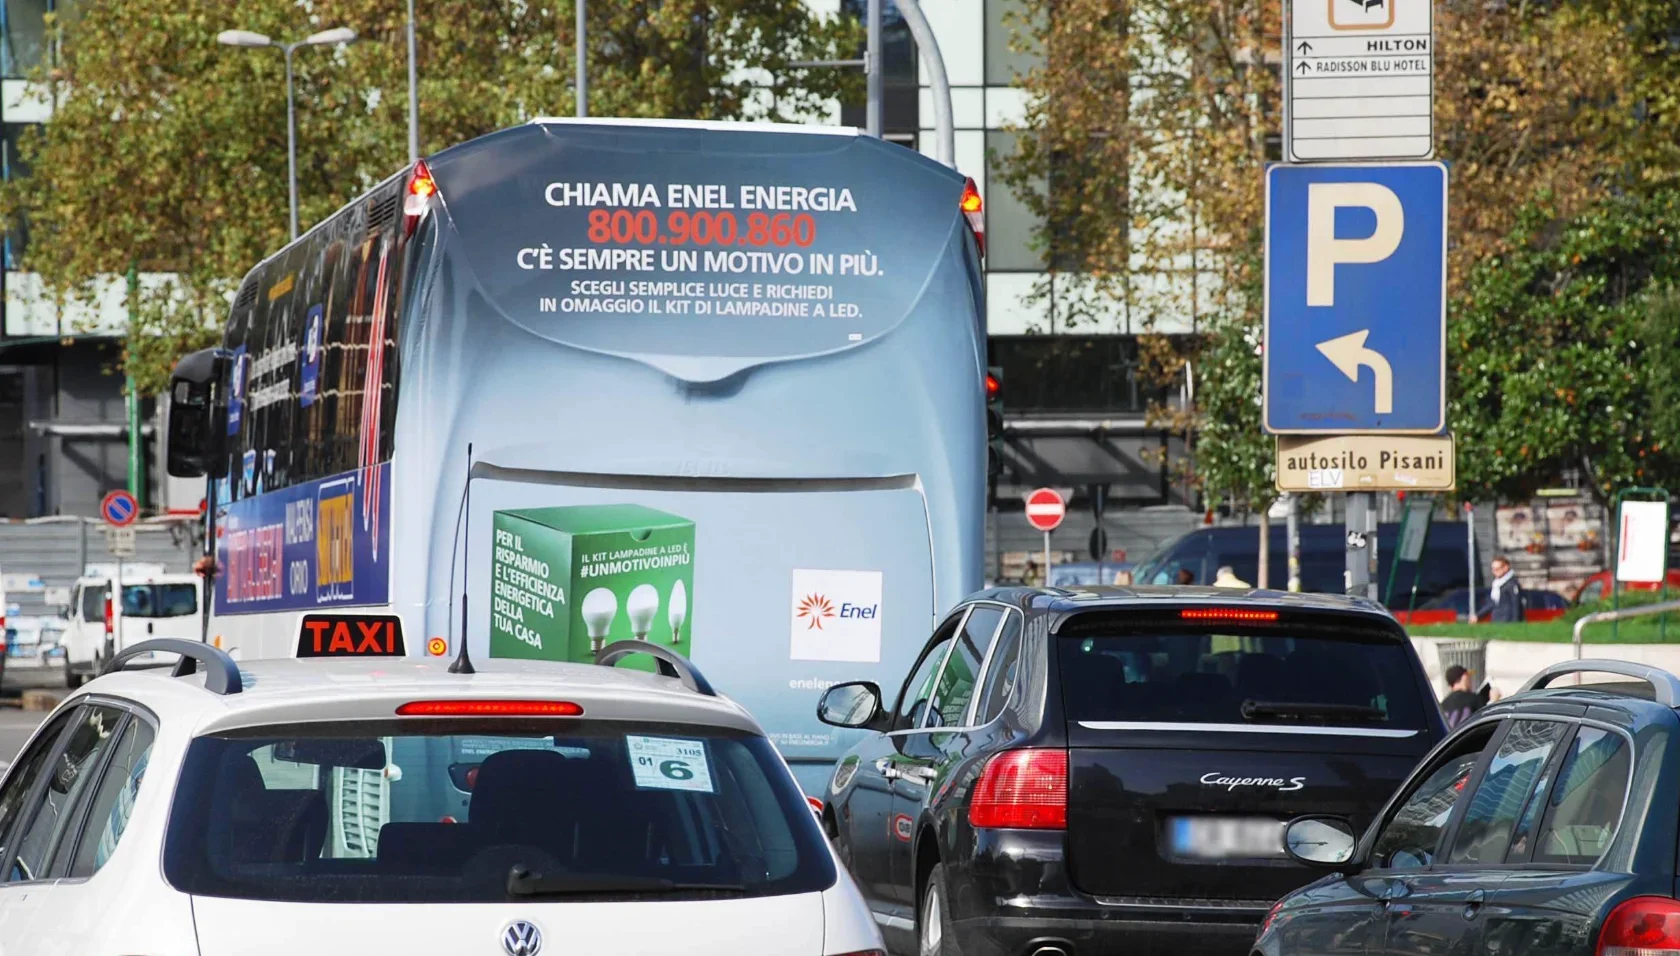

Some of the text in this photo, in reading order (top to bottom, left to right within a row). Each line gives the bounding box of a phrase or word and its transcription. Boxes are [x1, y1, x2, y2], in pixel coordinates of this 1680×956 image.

[1367, 39, 1427, 51] HILTON
[1316, 60, 1426, 72] RADISSON BLU HOTEL
[545, 182, 857, 212] CHIAMA ENEL ENERGIA
[587, 209, 816, 247] 800.900.860
[1306, 182, 1405, 306] P
[559, 248, 655, 271] SEMPRE
[661, 250, 697, 272] UN
[703, 251, 804, 274] MOTIVO
[809, 253, 834, 275] IN
[839, 250, 884, 277] PIÙ.
[571, 280, 833, 300] SCEGLI SEMPLICE LUCE E RICHIEDI
[539, 298, 863, 318] IN OMAGGIO IL KIT DI LAMPADINE A LED.
[1287, 450, 1443, 470] autosilo Pisani
[1309, 471, 1342, 487] ELV
[496, 529, 524, 552] PER IL
[496, 546, 549, 579] RISPARMIO
[581, 554, 590, 563] IL
[592, 552, 607, 562] KIT
[609, 547, 658, 560] LAMPADINE
[659, 546, 666, 554] A
[667, 544, 682, 553] LED
[495, 563, 565, 605] E L'EFFICIENZA
[494, 580, 554, 619] ENERGETICA
[494, 597, 524, 623] DELLA
[840, 603, 877, 619] Enel
[305, 621, 394, 652] TAXI
[494, 613, 542, 650] TUA CASA
[638, 756, 694, 780] 01 6
[1200, 772, 1306, 792] Cayenne S
